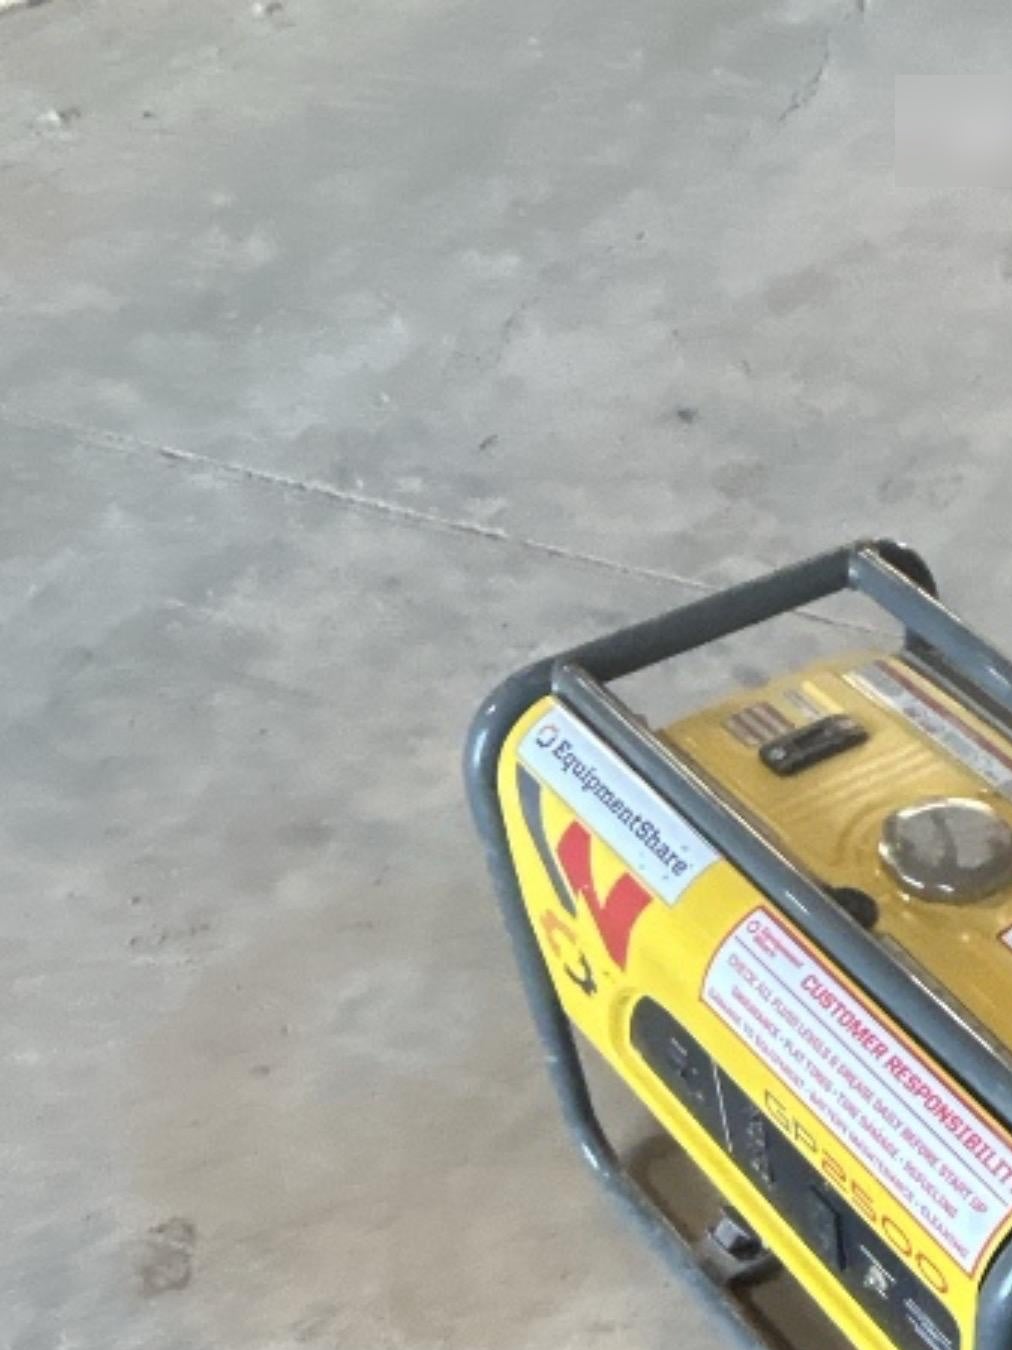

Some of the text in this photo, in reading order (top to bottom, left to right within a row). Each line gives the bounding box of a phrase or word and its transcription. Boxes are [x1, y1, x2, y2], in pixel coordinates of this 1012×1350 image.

[552, 741, 688, 876] EquipmentShare
[801, 974, 889, 1060] CUSTOMER
[764, 1089, 948, 1294] GP2500
